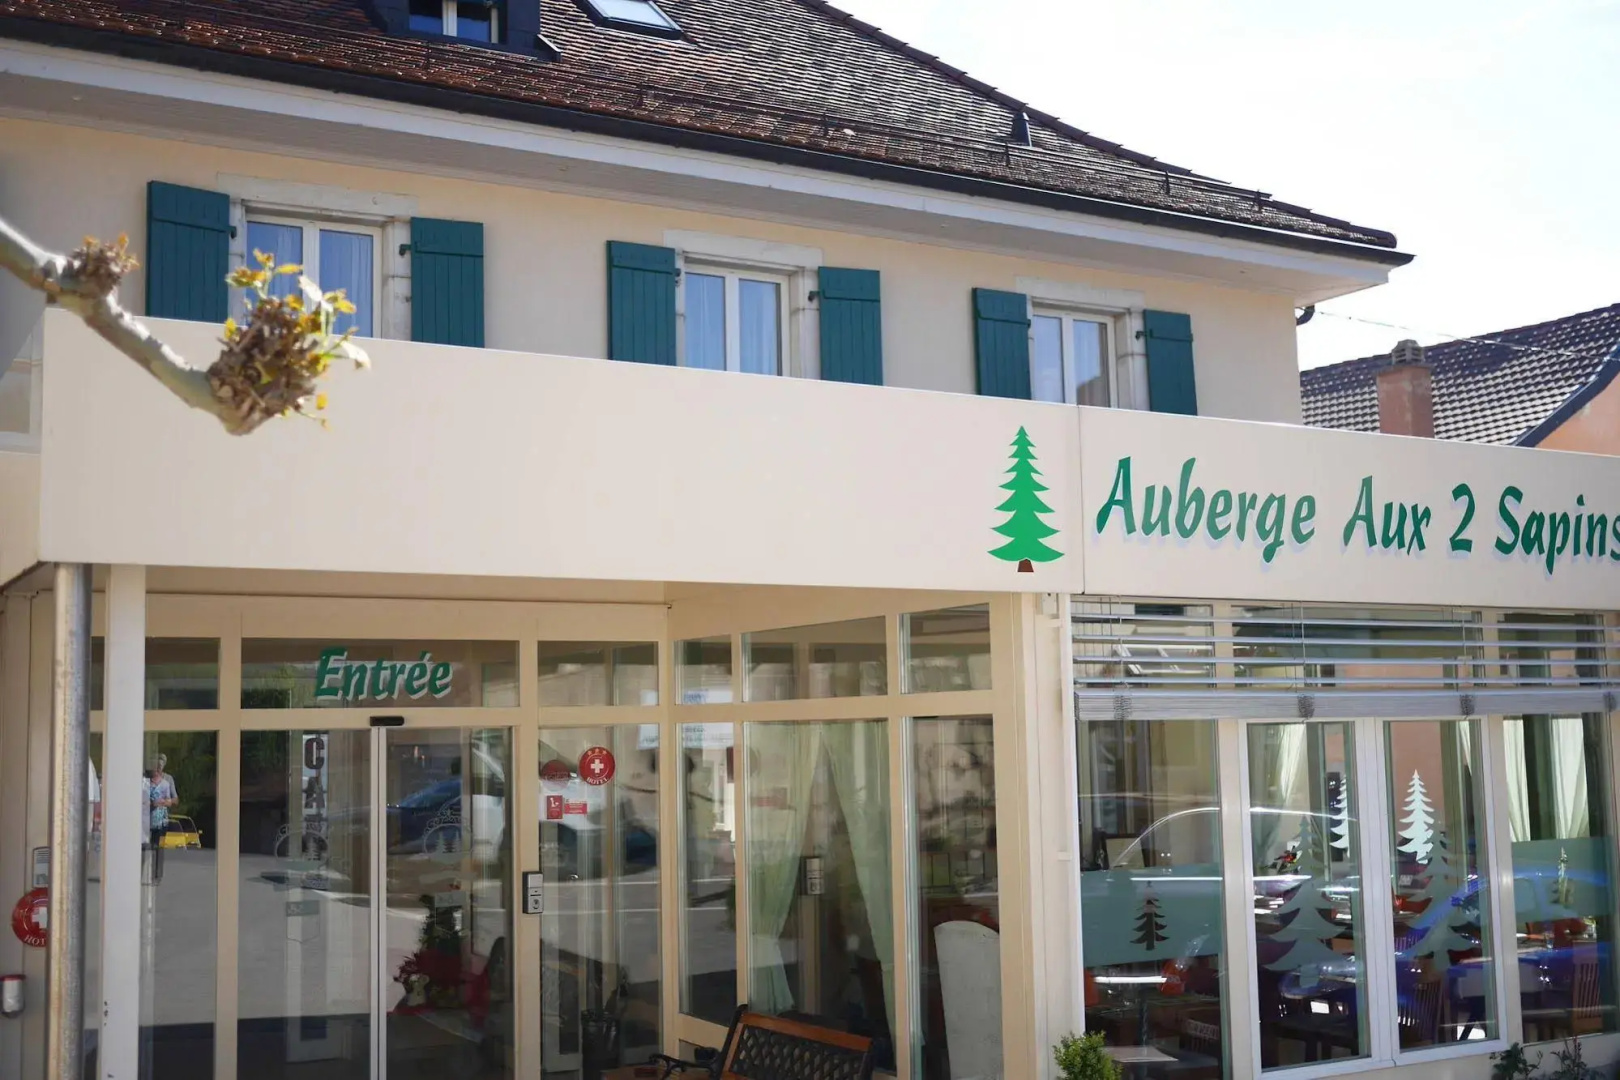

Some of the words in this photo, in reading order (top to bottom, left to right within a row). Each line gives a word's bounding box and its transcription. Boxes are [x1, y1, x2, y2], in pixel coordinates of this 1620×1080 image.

[1096, 456, 1316, 564] Auberge
[1343, 475, 1433, 556] Aux
[1449, 483, 1477, 554] 2
[1494, 485, 1620, 576] Sapins
[314, 646, 453, 700] Entrée
[586, 776, 608, 785] HOTEL
